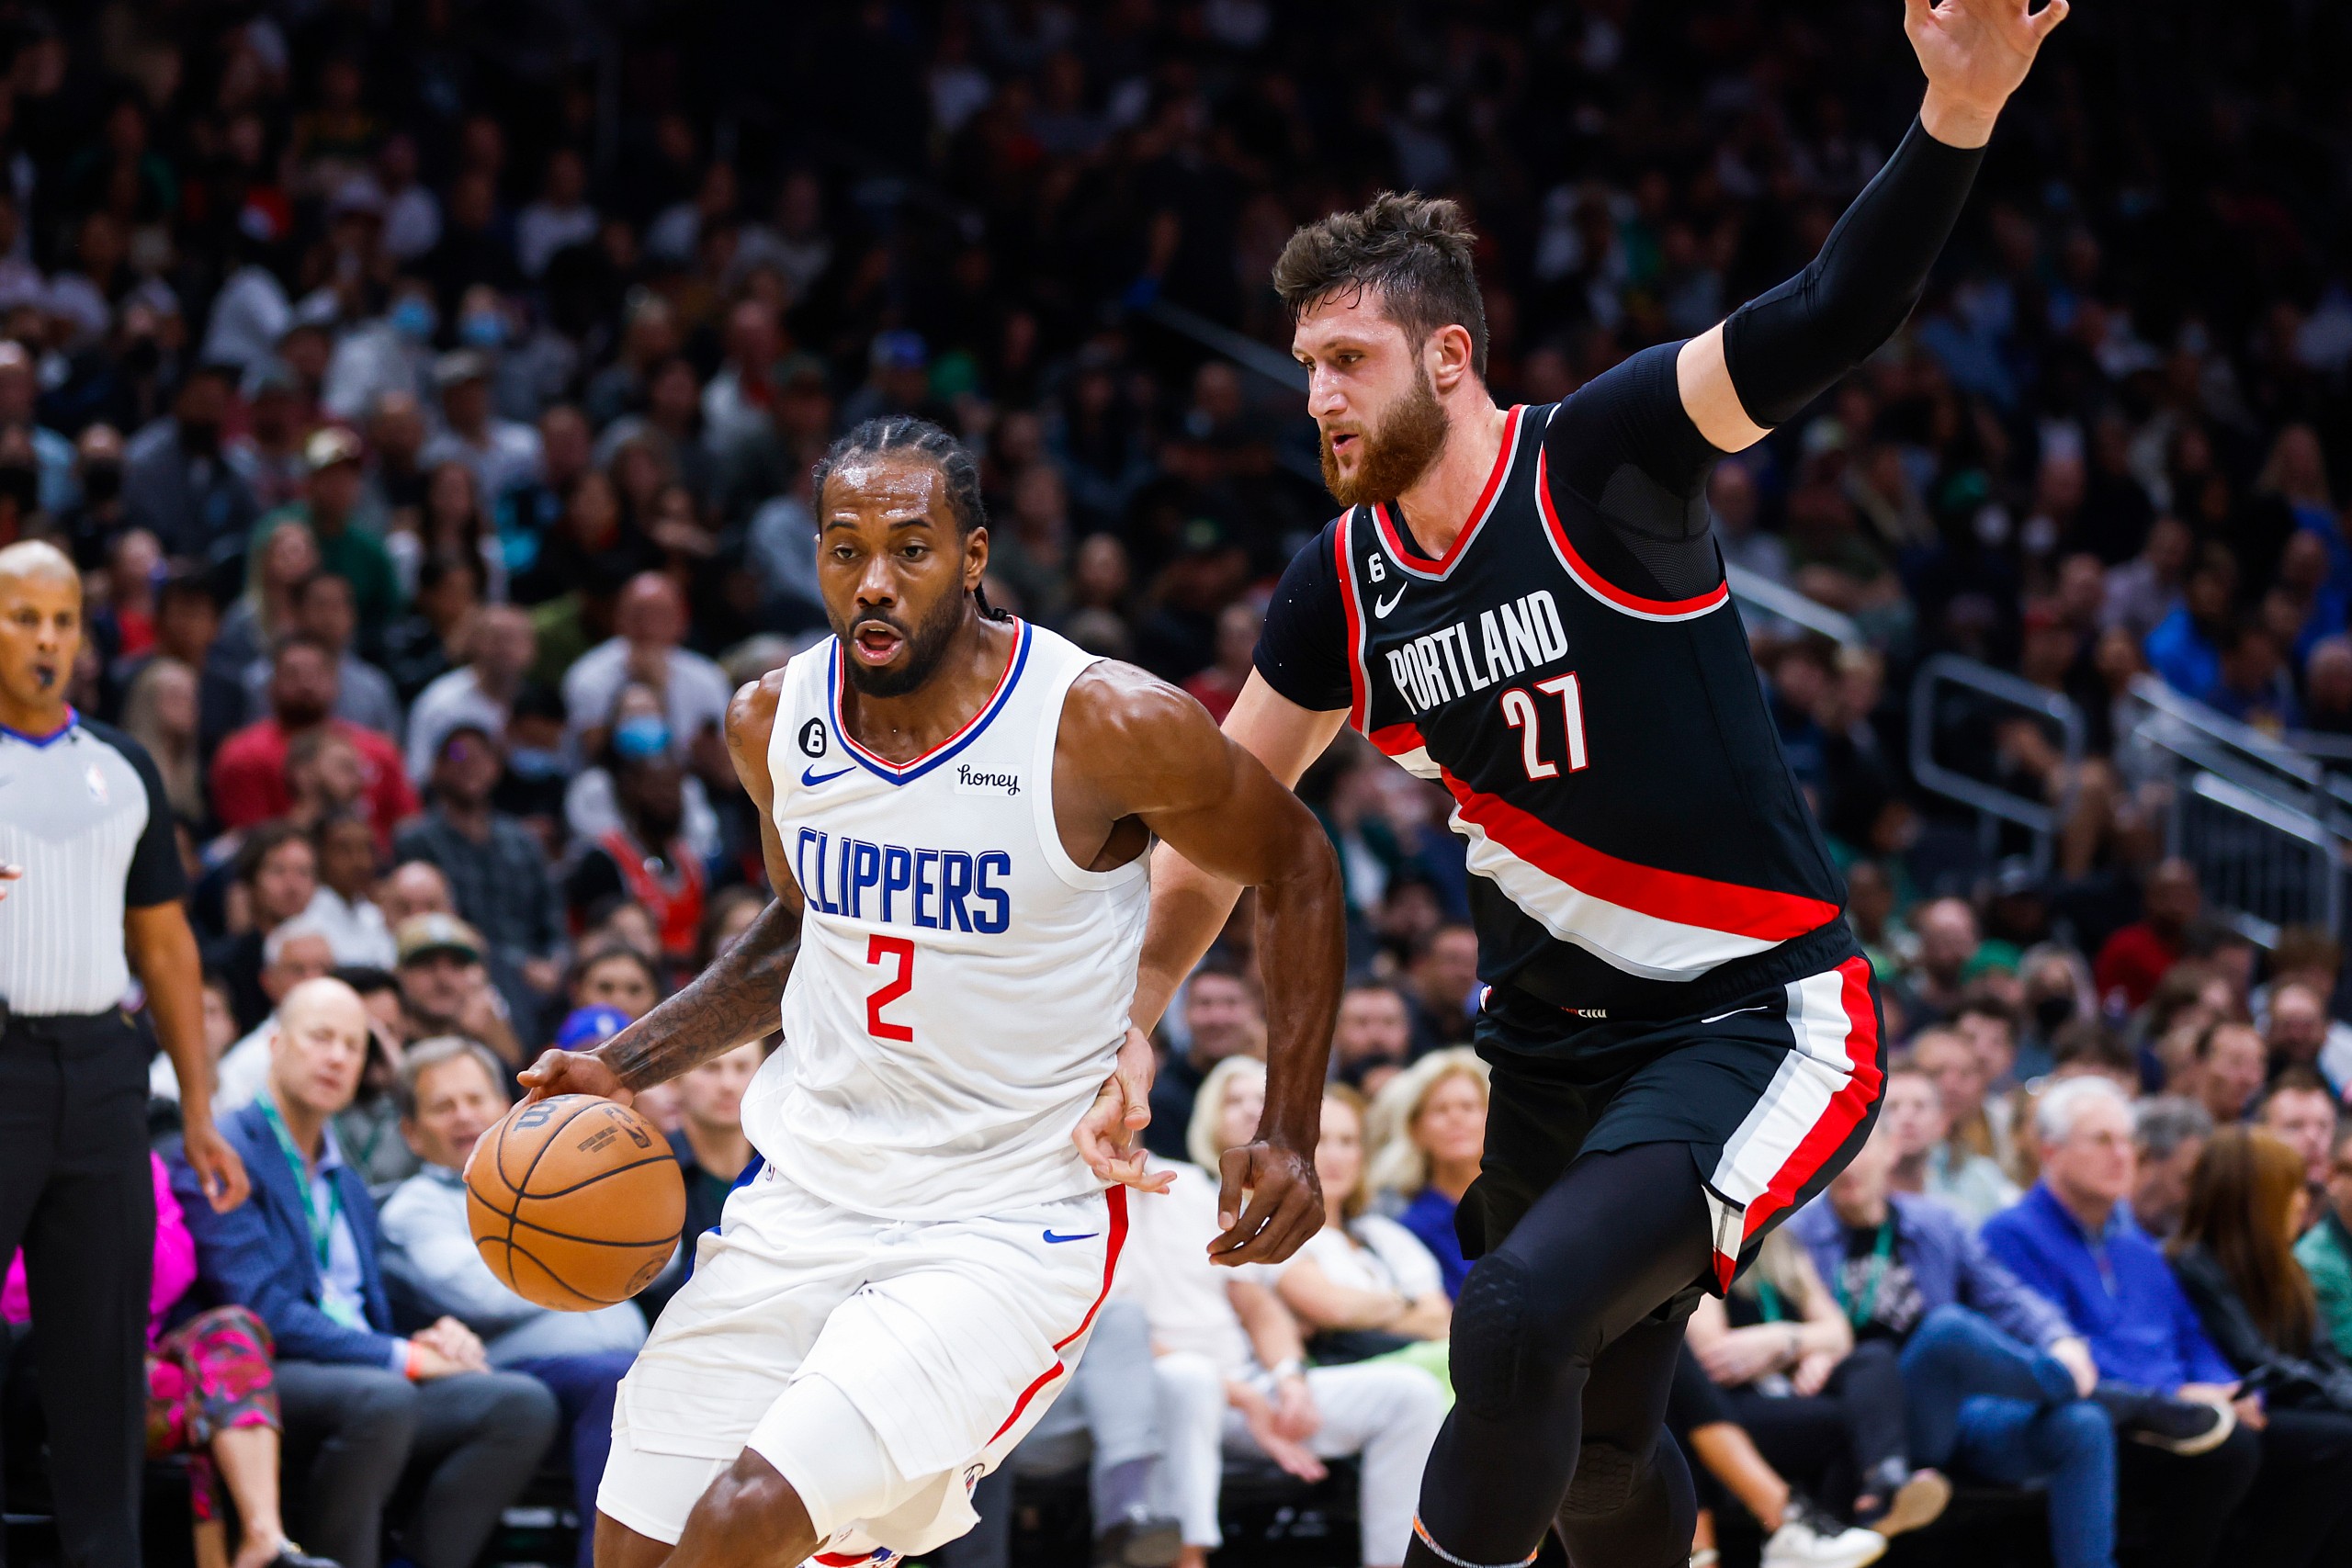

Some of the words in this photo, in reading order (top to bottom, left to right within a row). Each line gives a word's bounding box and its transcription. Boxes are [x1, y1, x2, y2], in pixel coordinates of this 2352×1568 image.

[1368, 552, 1385, 582] 6
[1385, 590, 1568, 715] PORTLAND
[806, 724, 823, 752] 6
[956, 764, 1020, 795] honey
[1499, 671, 1589, 781] 27
[797, 827, 1012, 934] CLIPPERS
[866, 934, 914, 1043] 2
